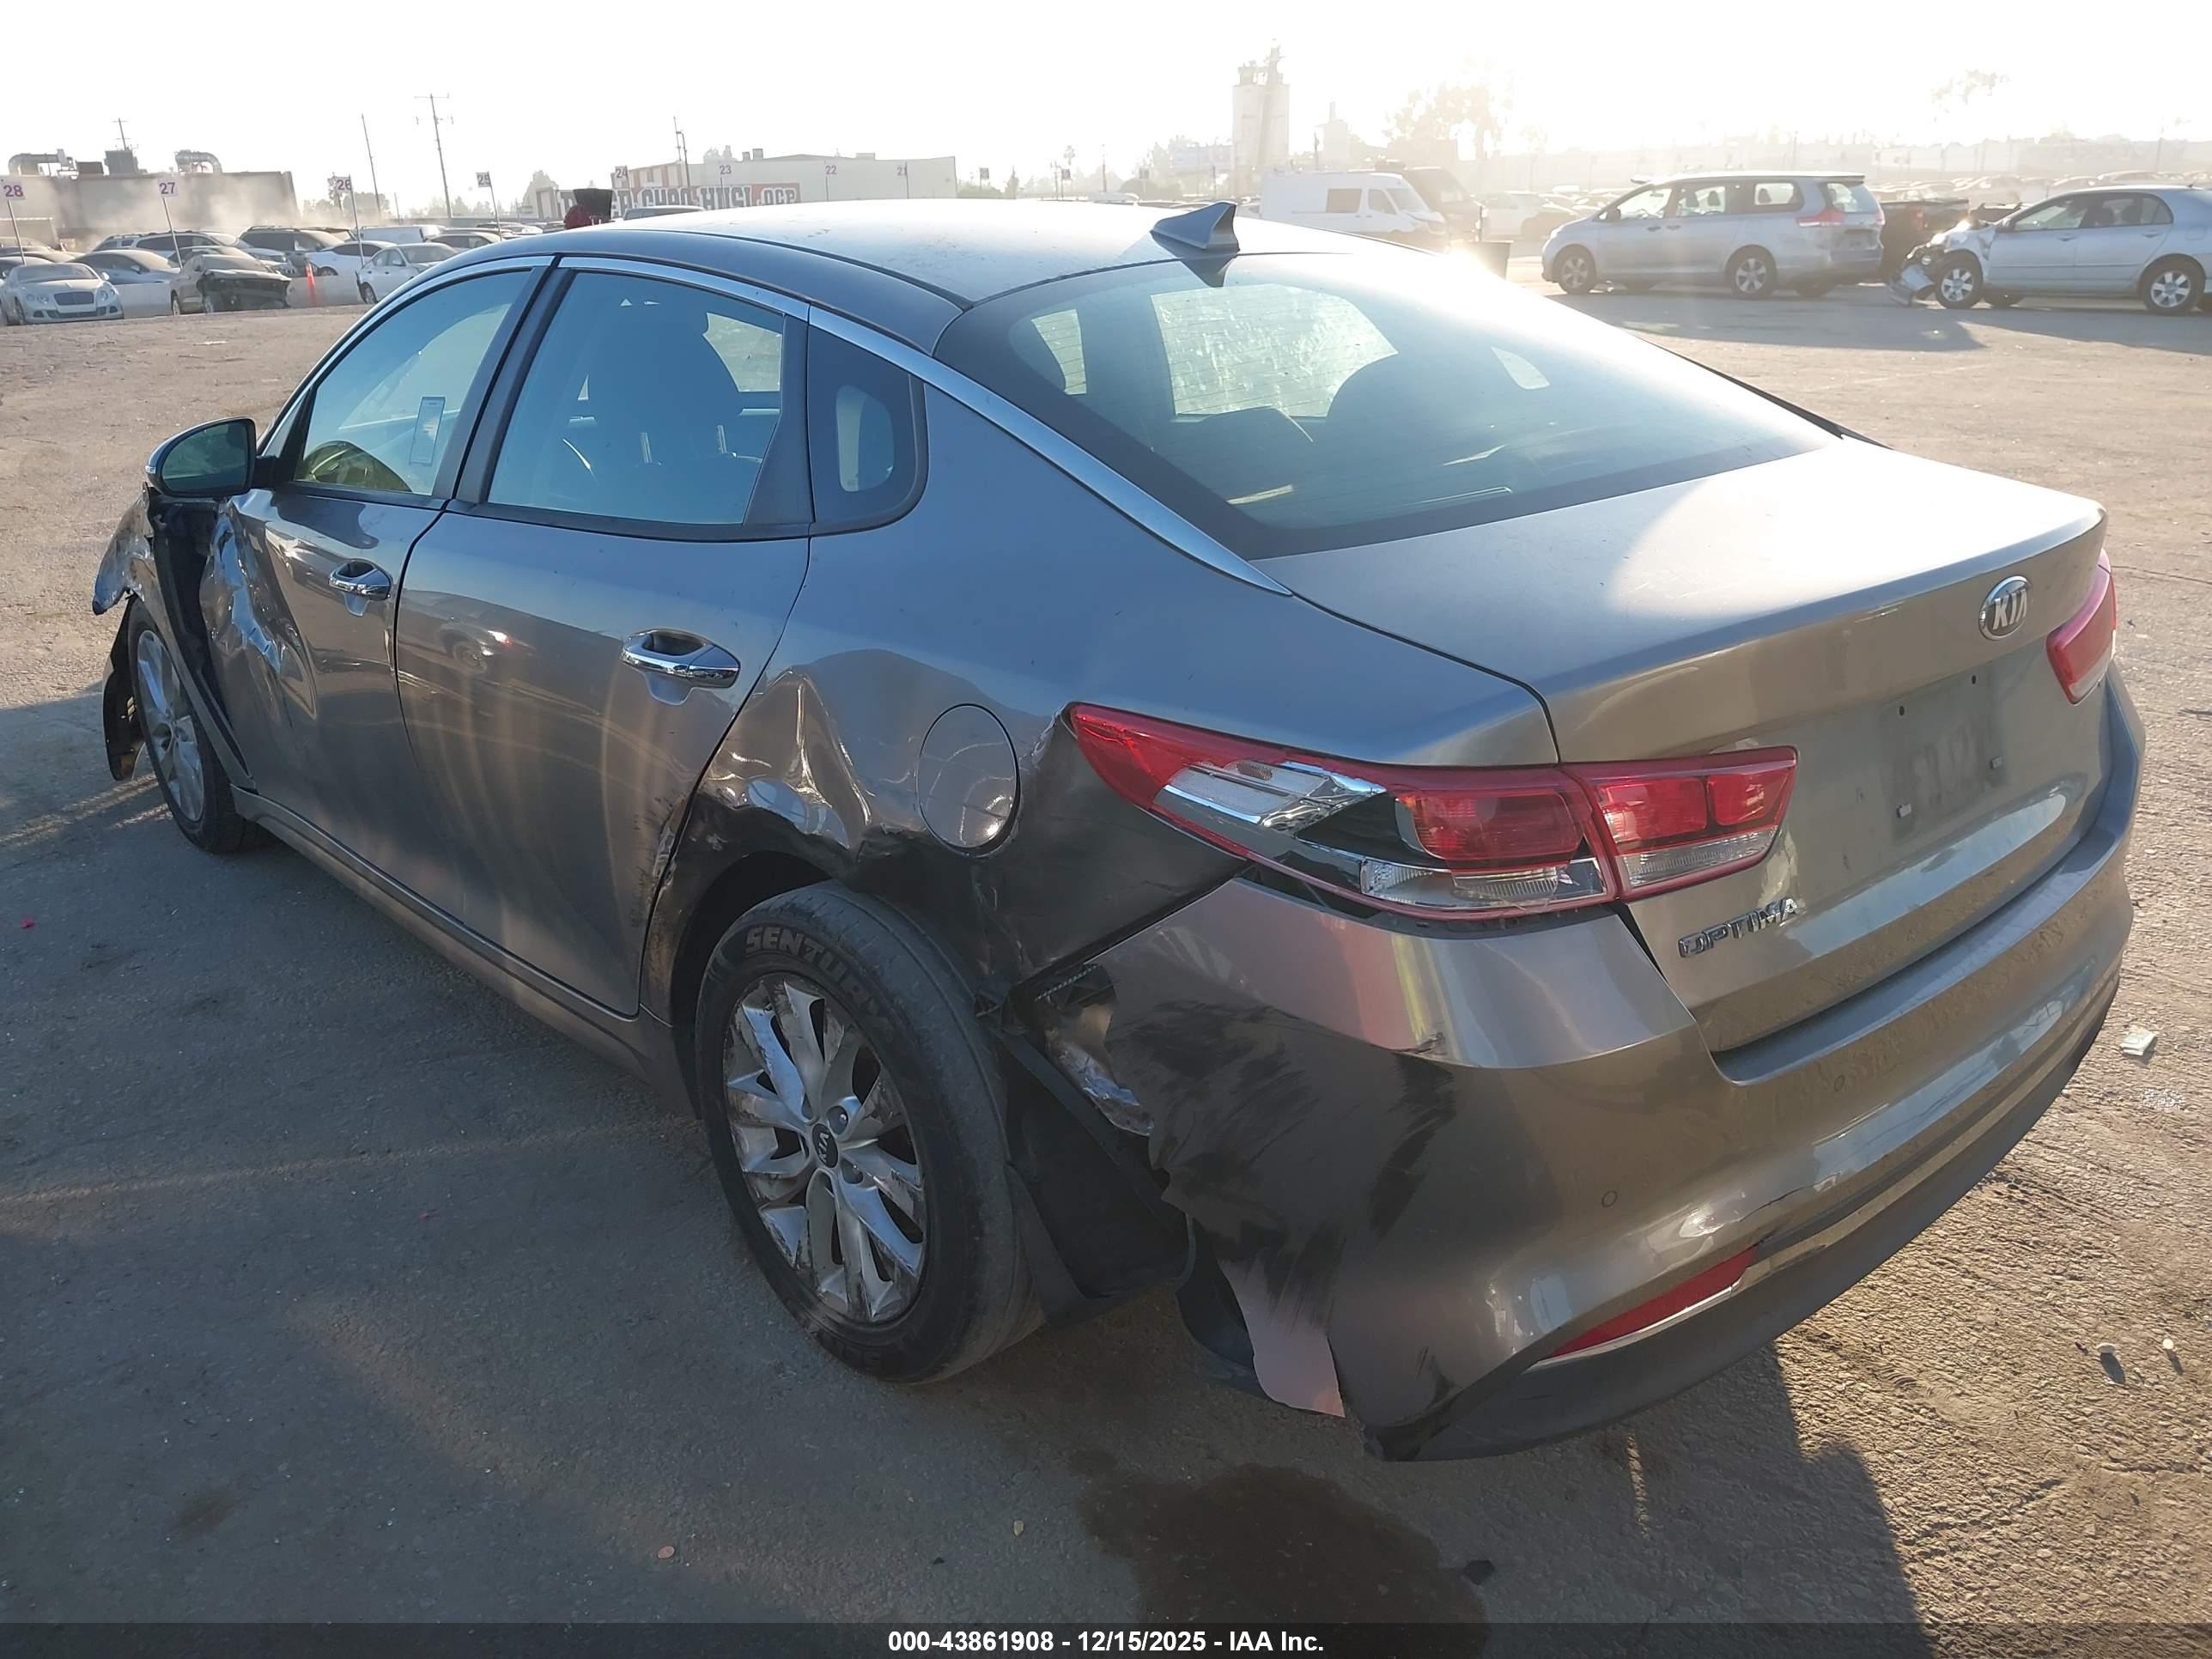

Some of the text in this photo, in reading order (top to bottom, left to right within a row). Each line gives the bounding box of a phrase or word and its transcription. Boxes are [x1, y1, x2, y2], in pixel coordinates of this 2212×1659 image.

[615, 167, 627, 179] 24
[720, 164, 732, 175] 23
[825, 165, 837, 175] 22
[897, 166, 907, 176] 21
[159, 182, 176, 195] 27
[337, 179, 351, 191] 26
[3, 185, 23, 198] 28
[1991, 588, 2027, 630] KIA
[1678, 896, 1799, 957] OPTIMA
[817, 1133, 830, 1164] KIA
